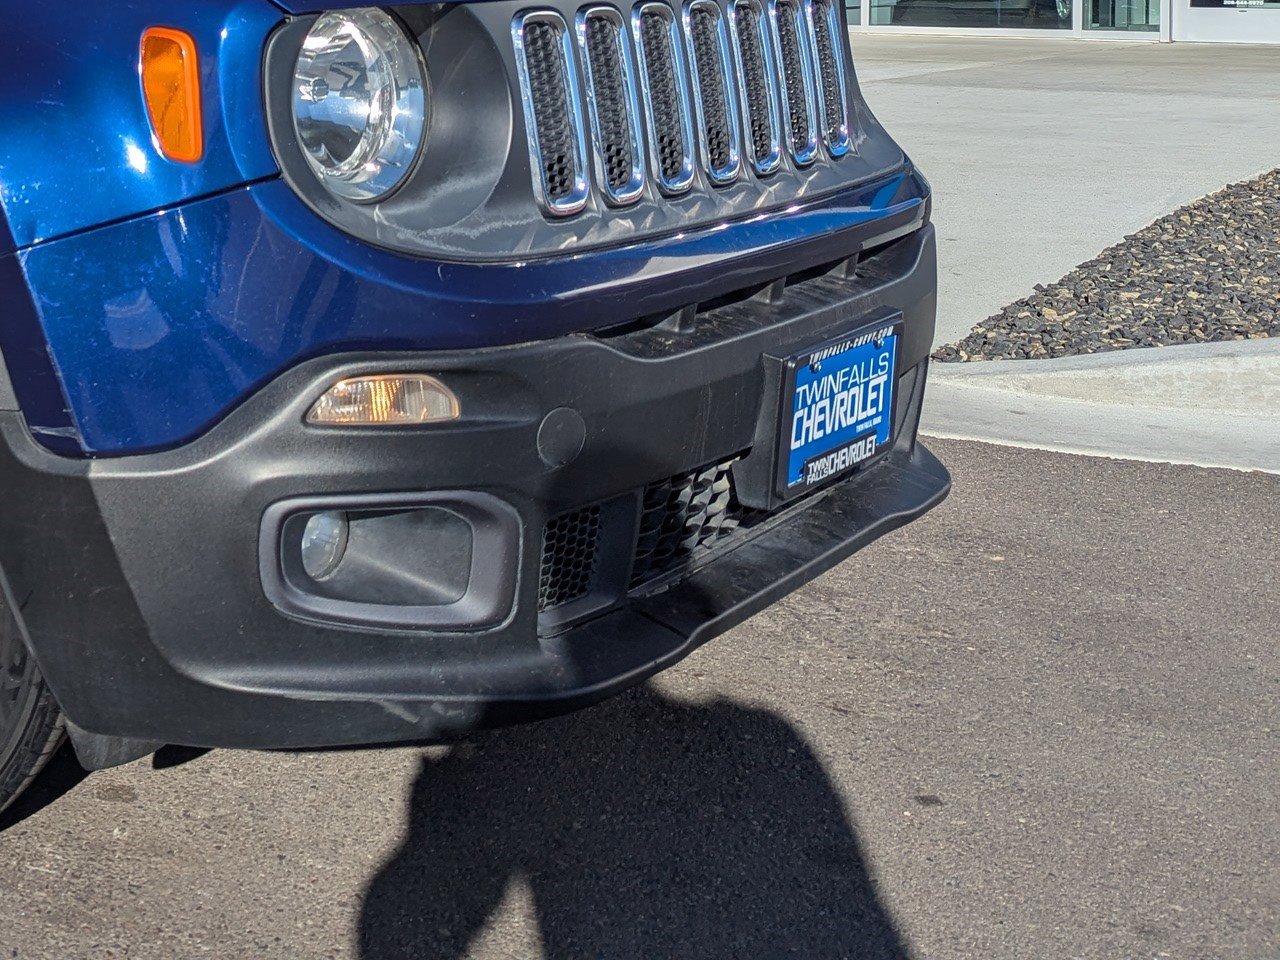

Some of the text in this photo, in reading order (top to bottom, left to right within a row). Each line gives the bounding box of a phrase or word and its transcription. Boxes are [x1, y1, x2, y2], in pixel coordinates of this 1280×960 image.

[796, 351, 890, 410] TWINFALLS
[790, 373, 888, 450] CHEVROLET
[807, 456, 829, 473] TWIN
[828, 434, 878, 474] CHEVROLET
[806, 467, 829, 486] FALLS
